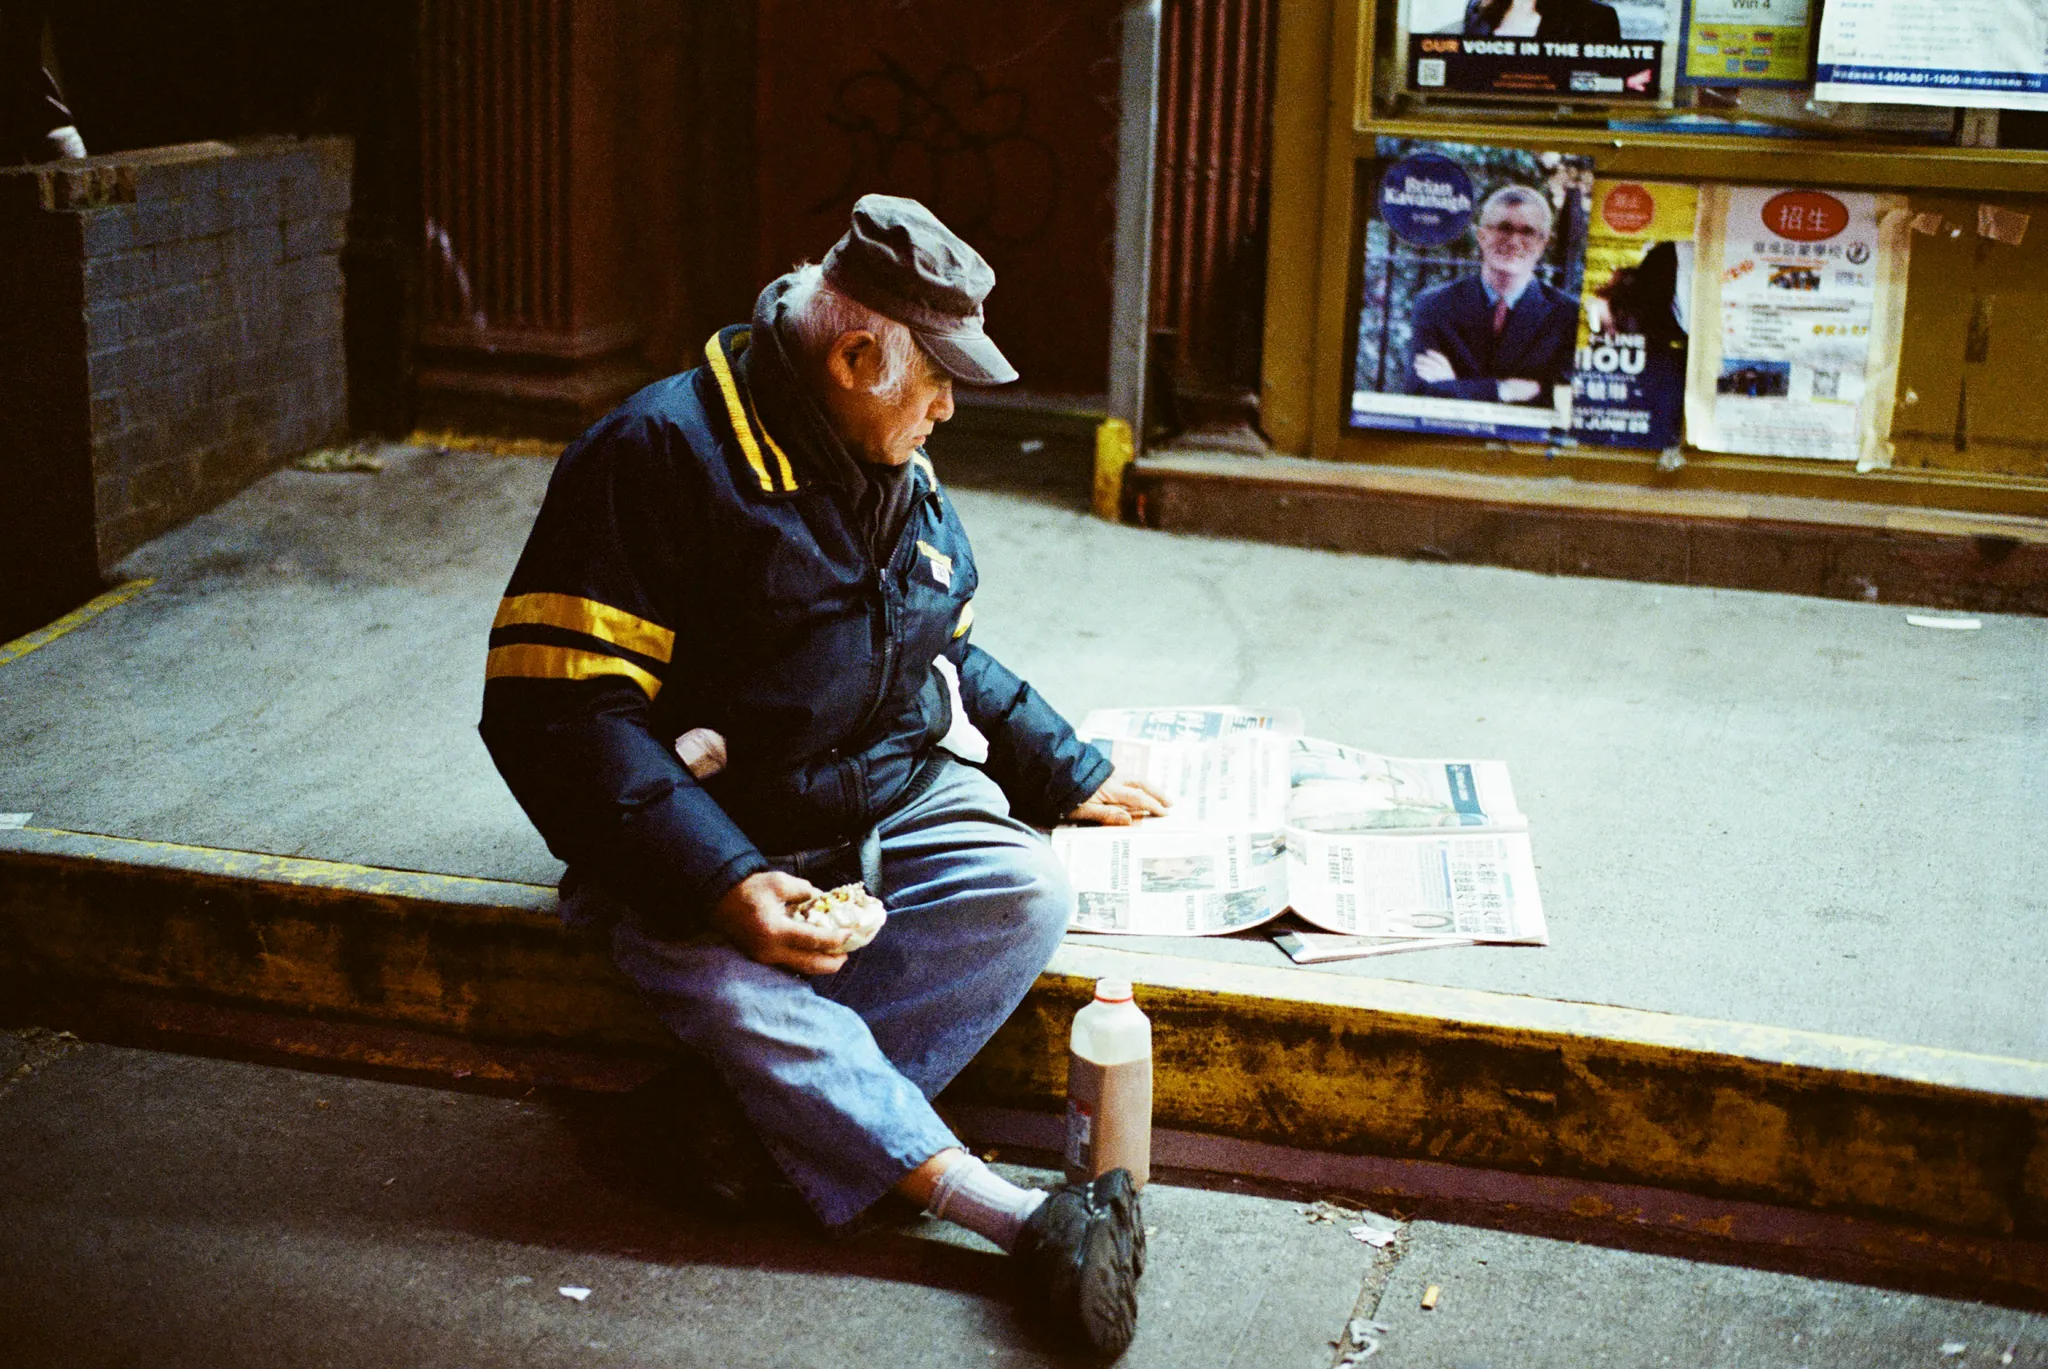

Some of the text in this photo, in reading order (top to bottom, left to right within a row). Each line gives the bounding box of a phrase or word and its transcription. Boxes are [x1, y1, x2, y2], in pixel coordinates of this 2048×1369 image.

[1421, 38, 1655, 60] OUR VOICE IN THE SENATE
[1405, 176, 1453, 197] Brian
[1384, 187, 1471, 214] Kavanagh
[1779, 204, 1831, 233] 招生
